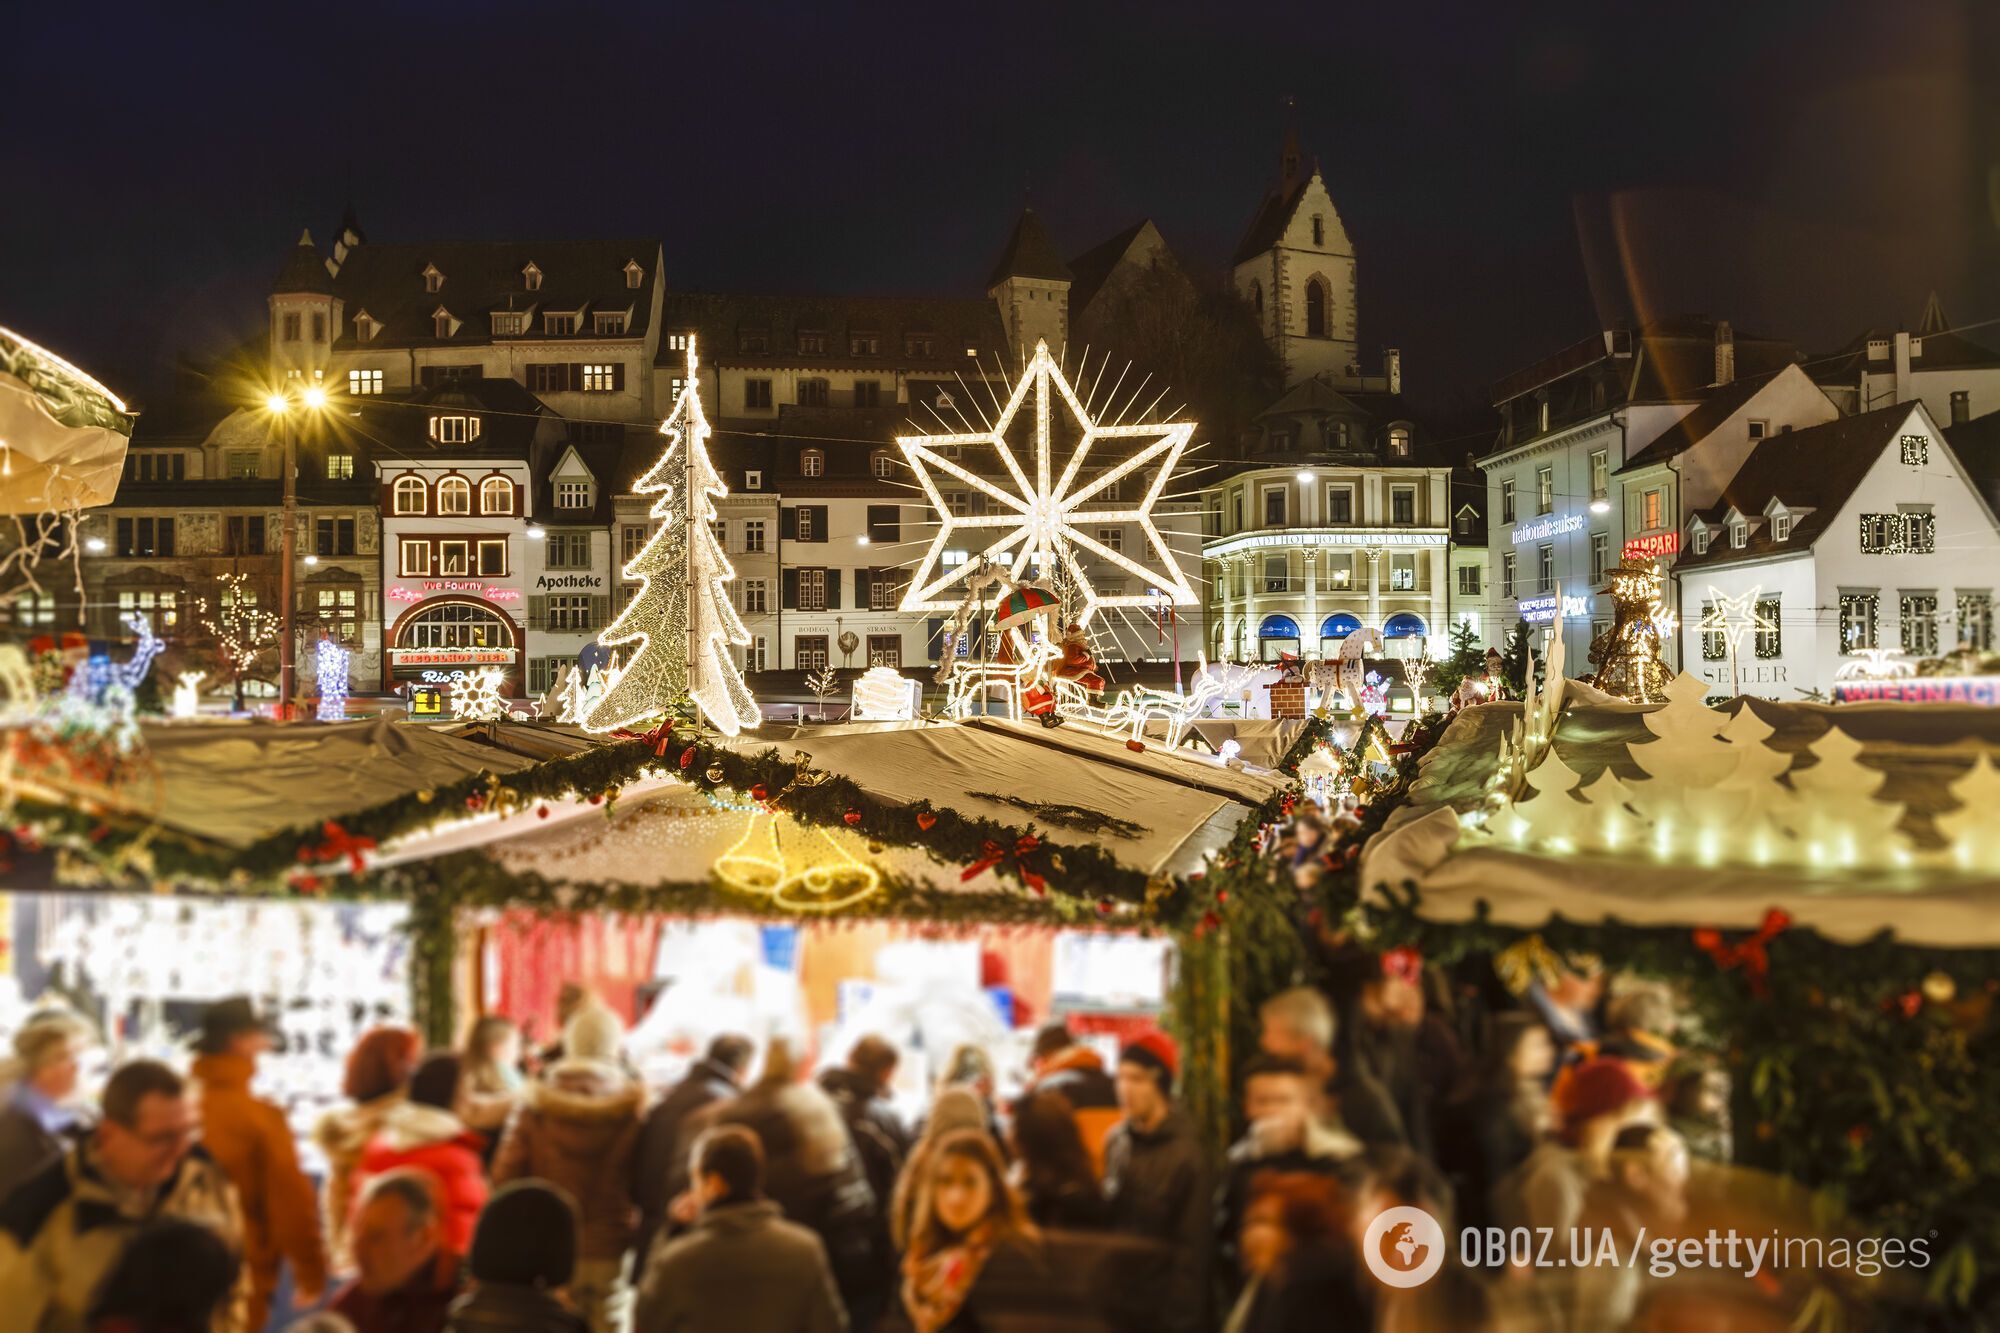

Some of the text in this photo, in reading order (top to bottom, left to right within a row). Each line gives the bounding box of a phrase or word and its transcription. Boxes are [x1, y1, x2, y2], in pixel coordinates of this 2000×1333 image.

[1512, 514, 1583, 544] nationalesuisse
[1314, 535, 1353, 544] HOTEL
[1361, 535, 1444, 544] RESTAURANT
[444, 581, 482, 591] Fourny
[536, 574, 602, 591] Apotheke
[1561, 596, 1587, 617] Pax
[400, 653, 508, 664] ZIEGELHOF BIER
[422, 670, 451, 682] Rio
[1703, 666, 1787, 683] SELER
